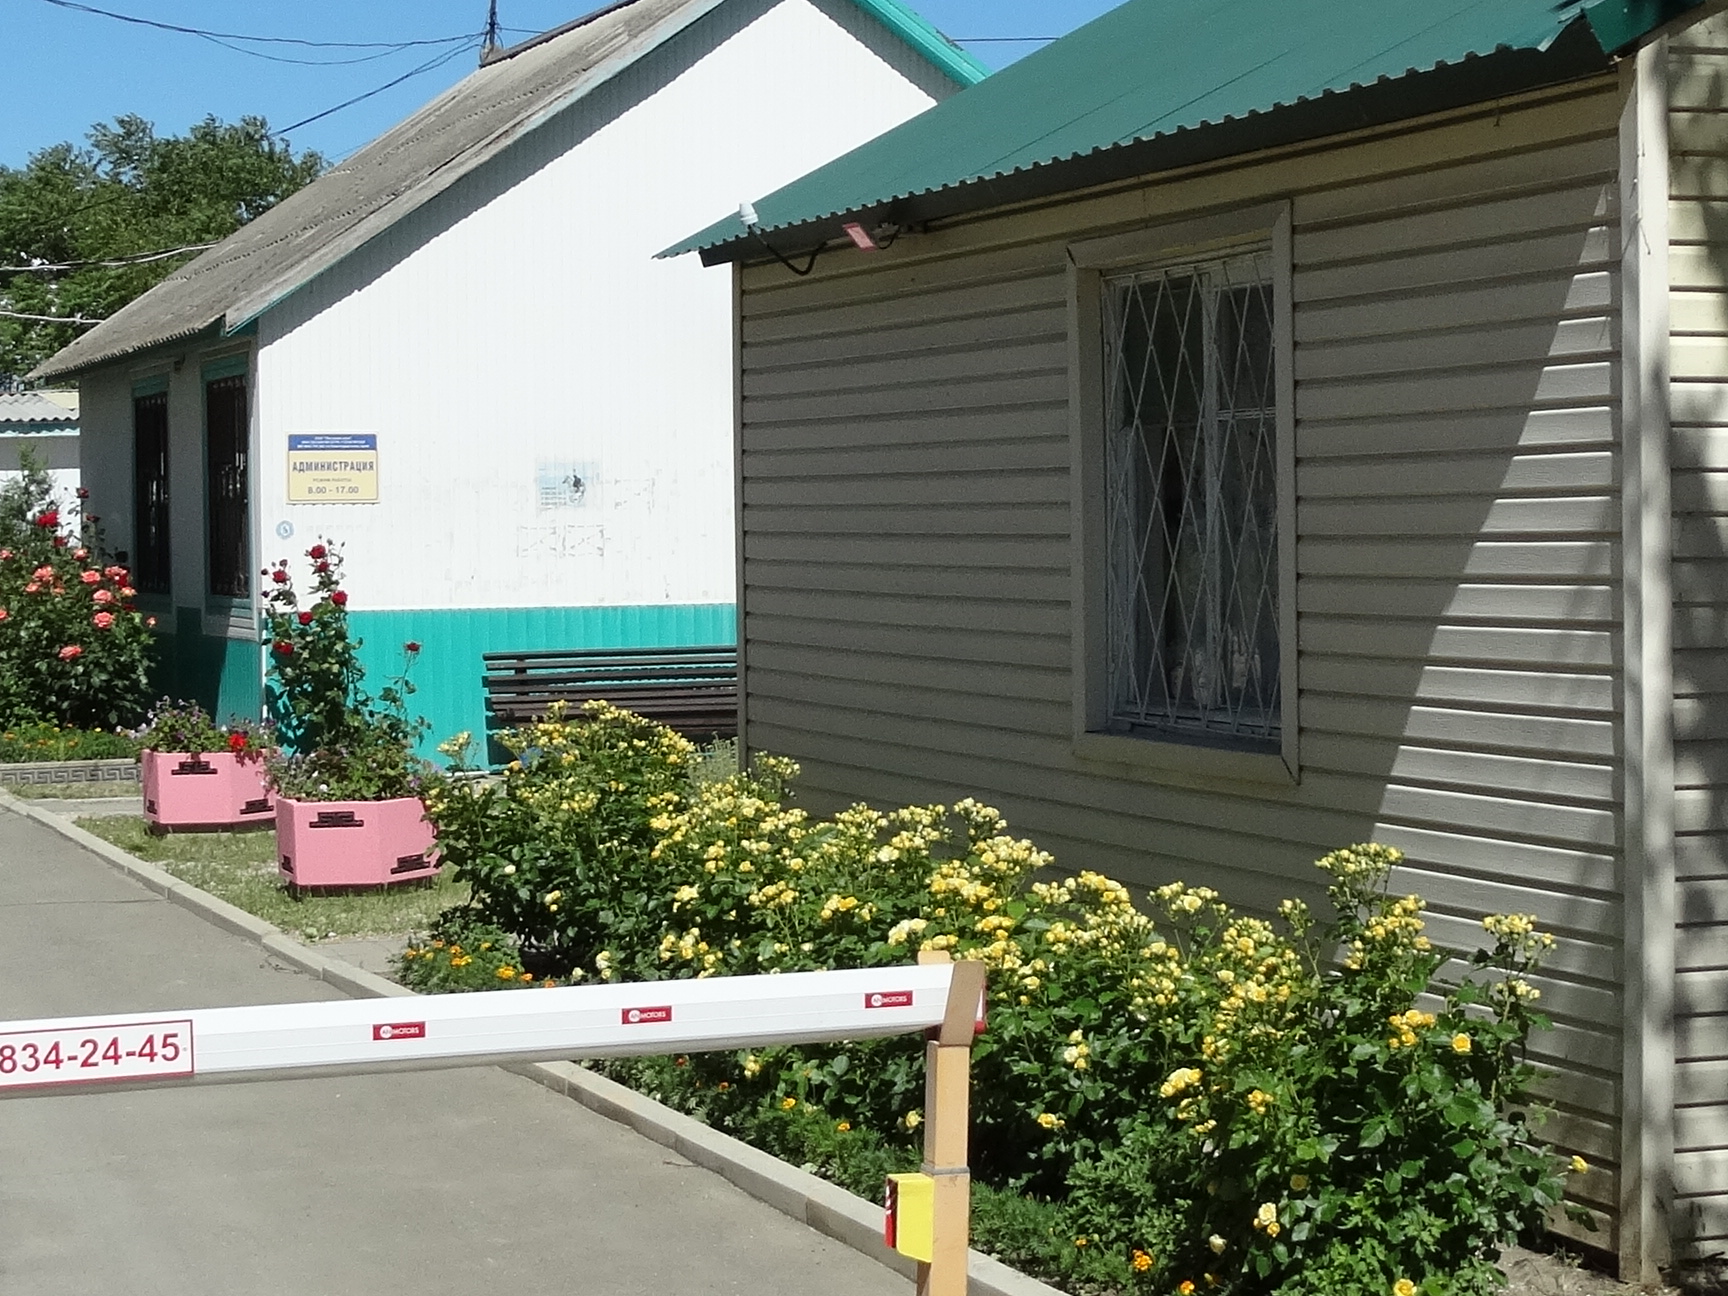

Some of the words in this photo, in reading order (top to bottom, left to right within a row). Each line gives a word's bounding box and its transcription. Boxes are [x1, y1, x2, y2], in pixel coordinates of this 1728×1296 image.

[292, 461, 374, 473] АДМИНИСТРАЦИЯ
[307, 486, 327, 494] 8.00
[335, 486, 359, 494] 17.00
